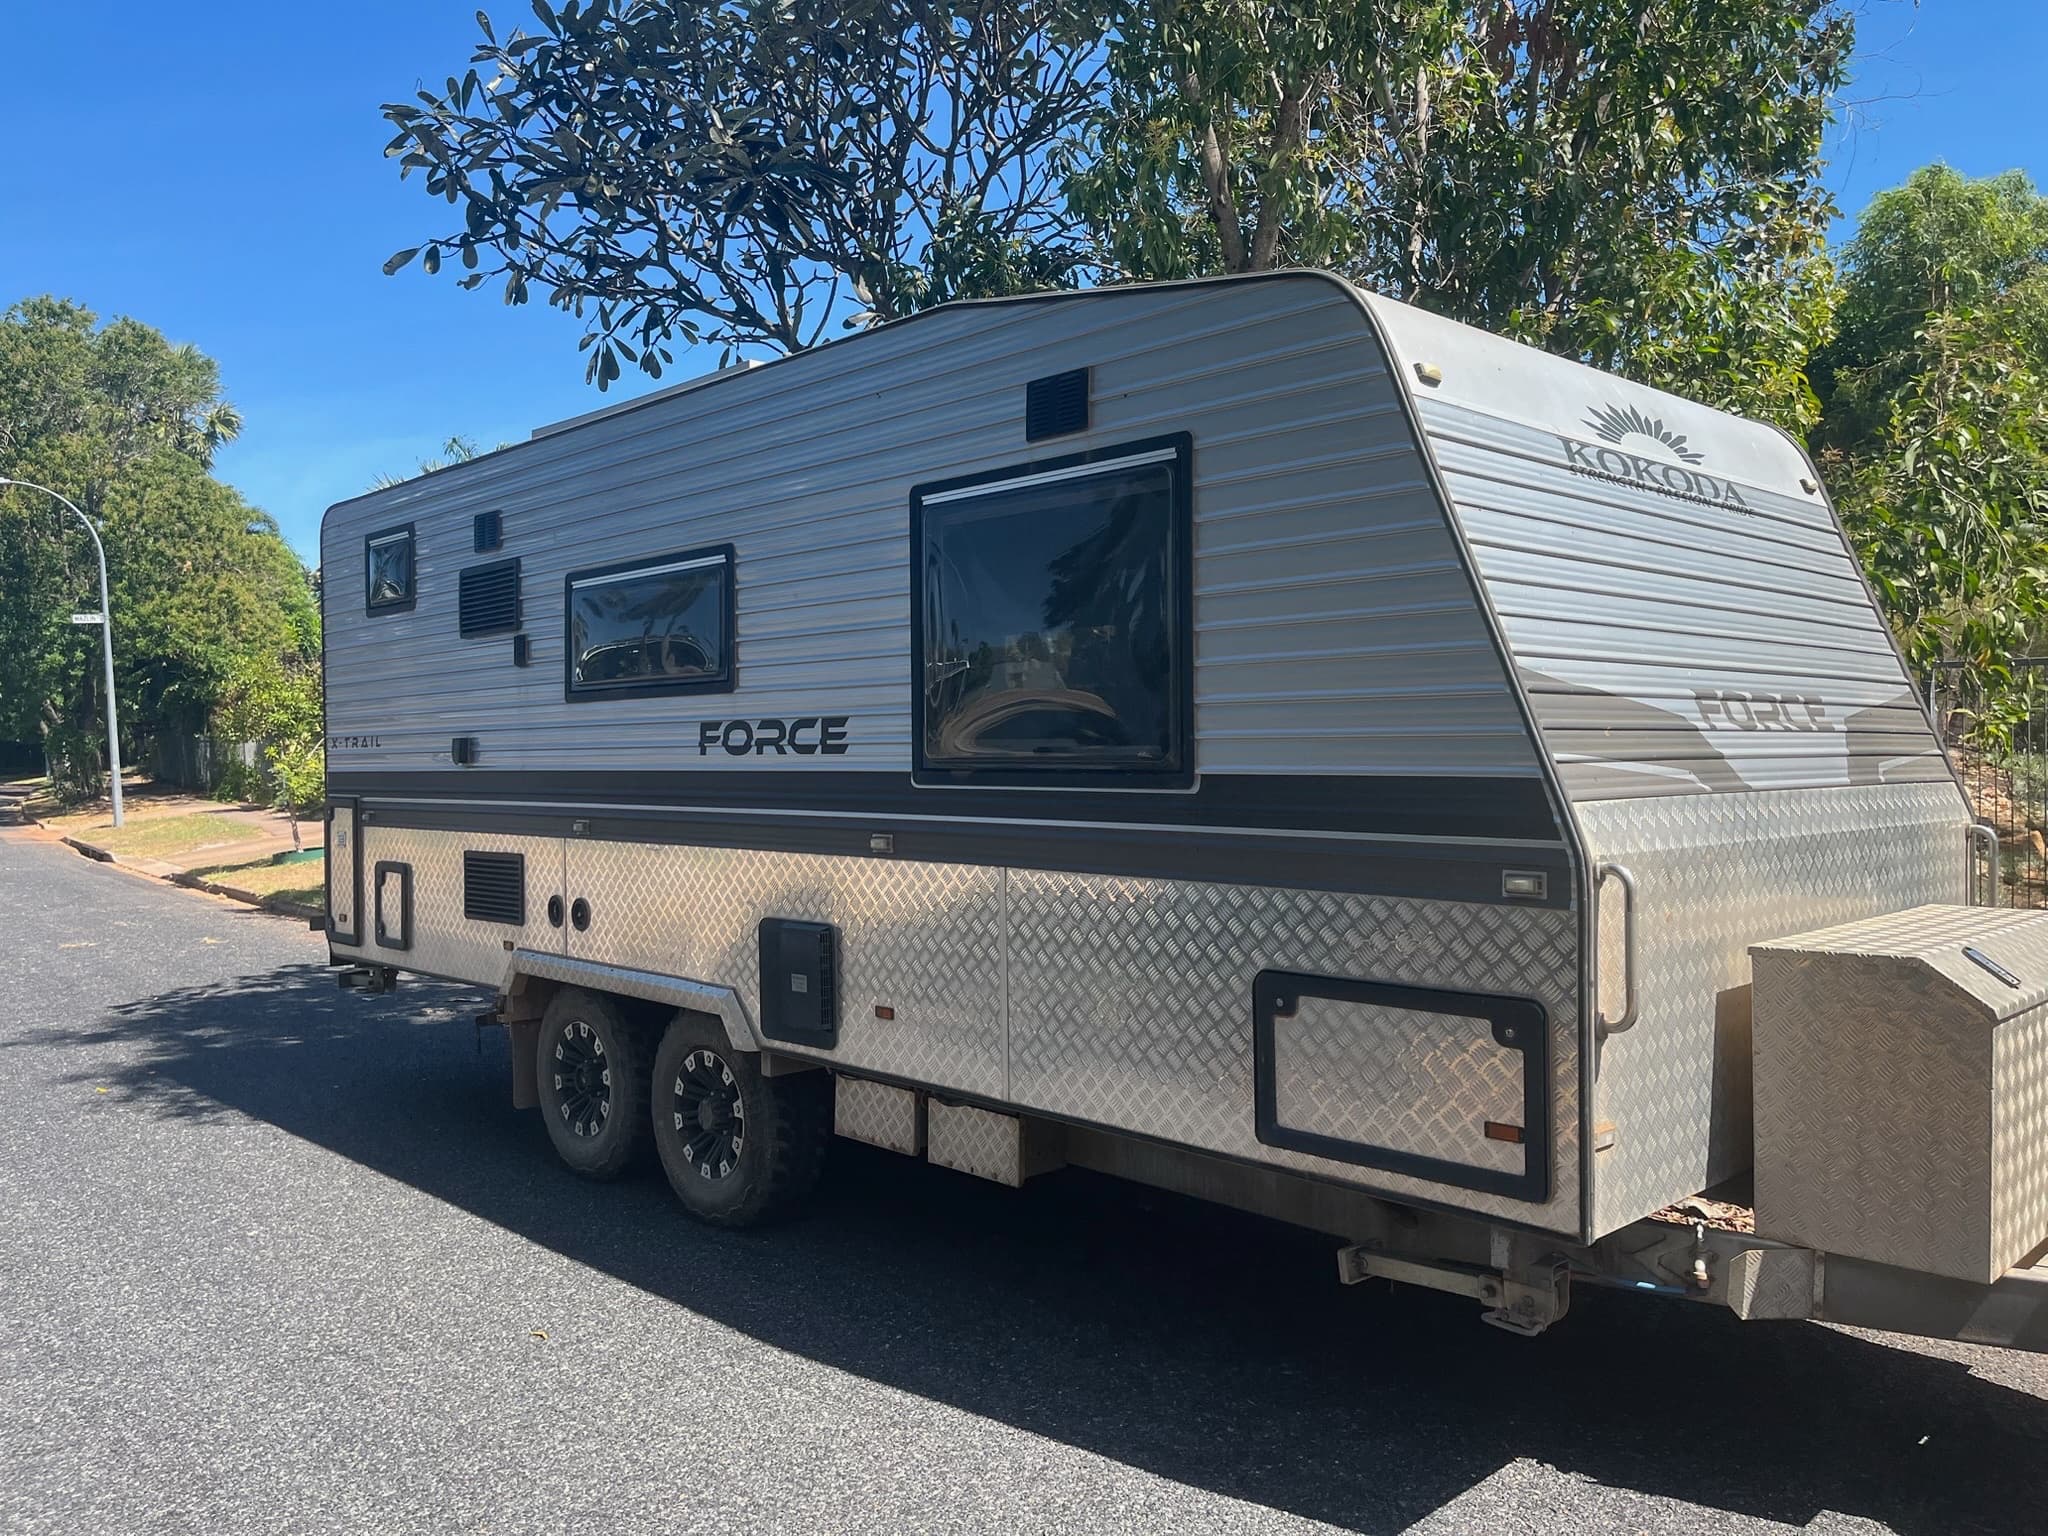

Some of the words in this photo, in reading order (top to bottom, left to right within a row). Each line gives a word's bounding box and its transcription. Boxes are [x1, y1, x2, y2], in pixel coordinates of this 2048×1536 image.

[1557, 437, 1750, 507] KOKODA
[1568, 463, 1646, 493] STRENGTH
[1656, 485, 1712, 509] PASSION
[1690, 688, 1838, 732] FORCE
[331, 735, 382, 749] X-TRAIL
[698, 716, 850, 756] FORCE
